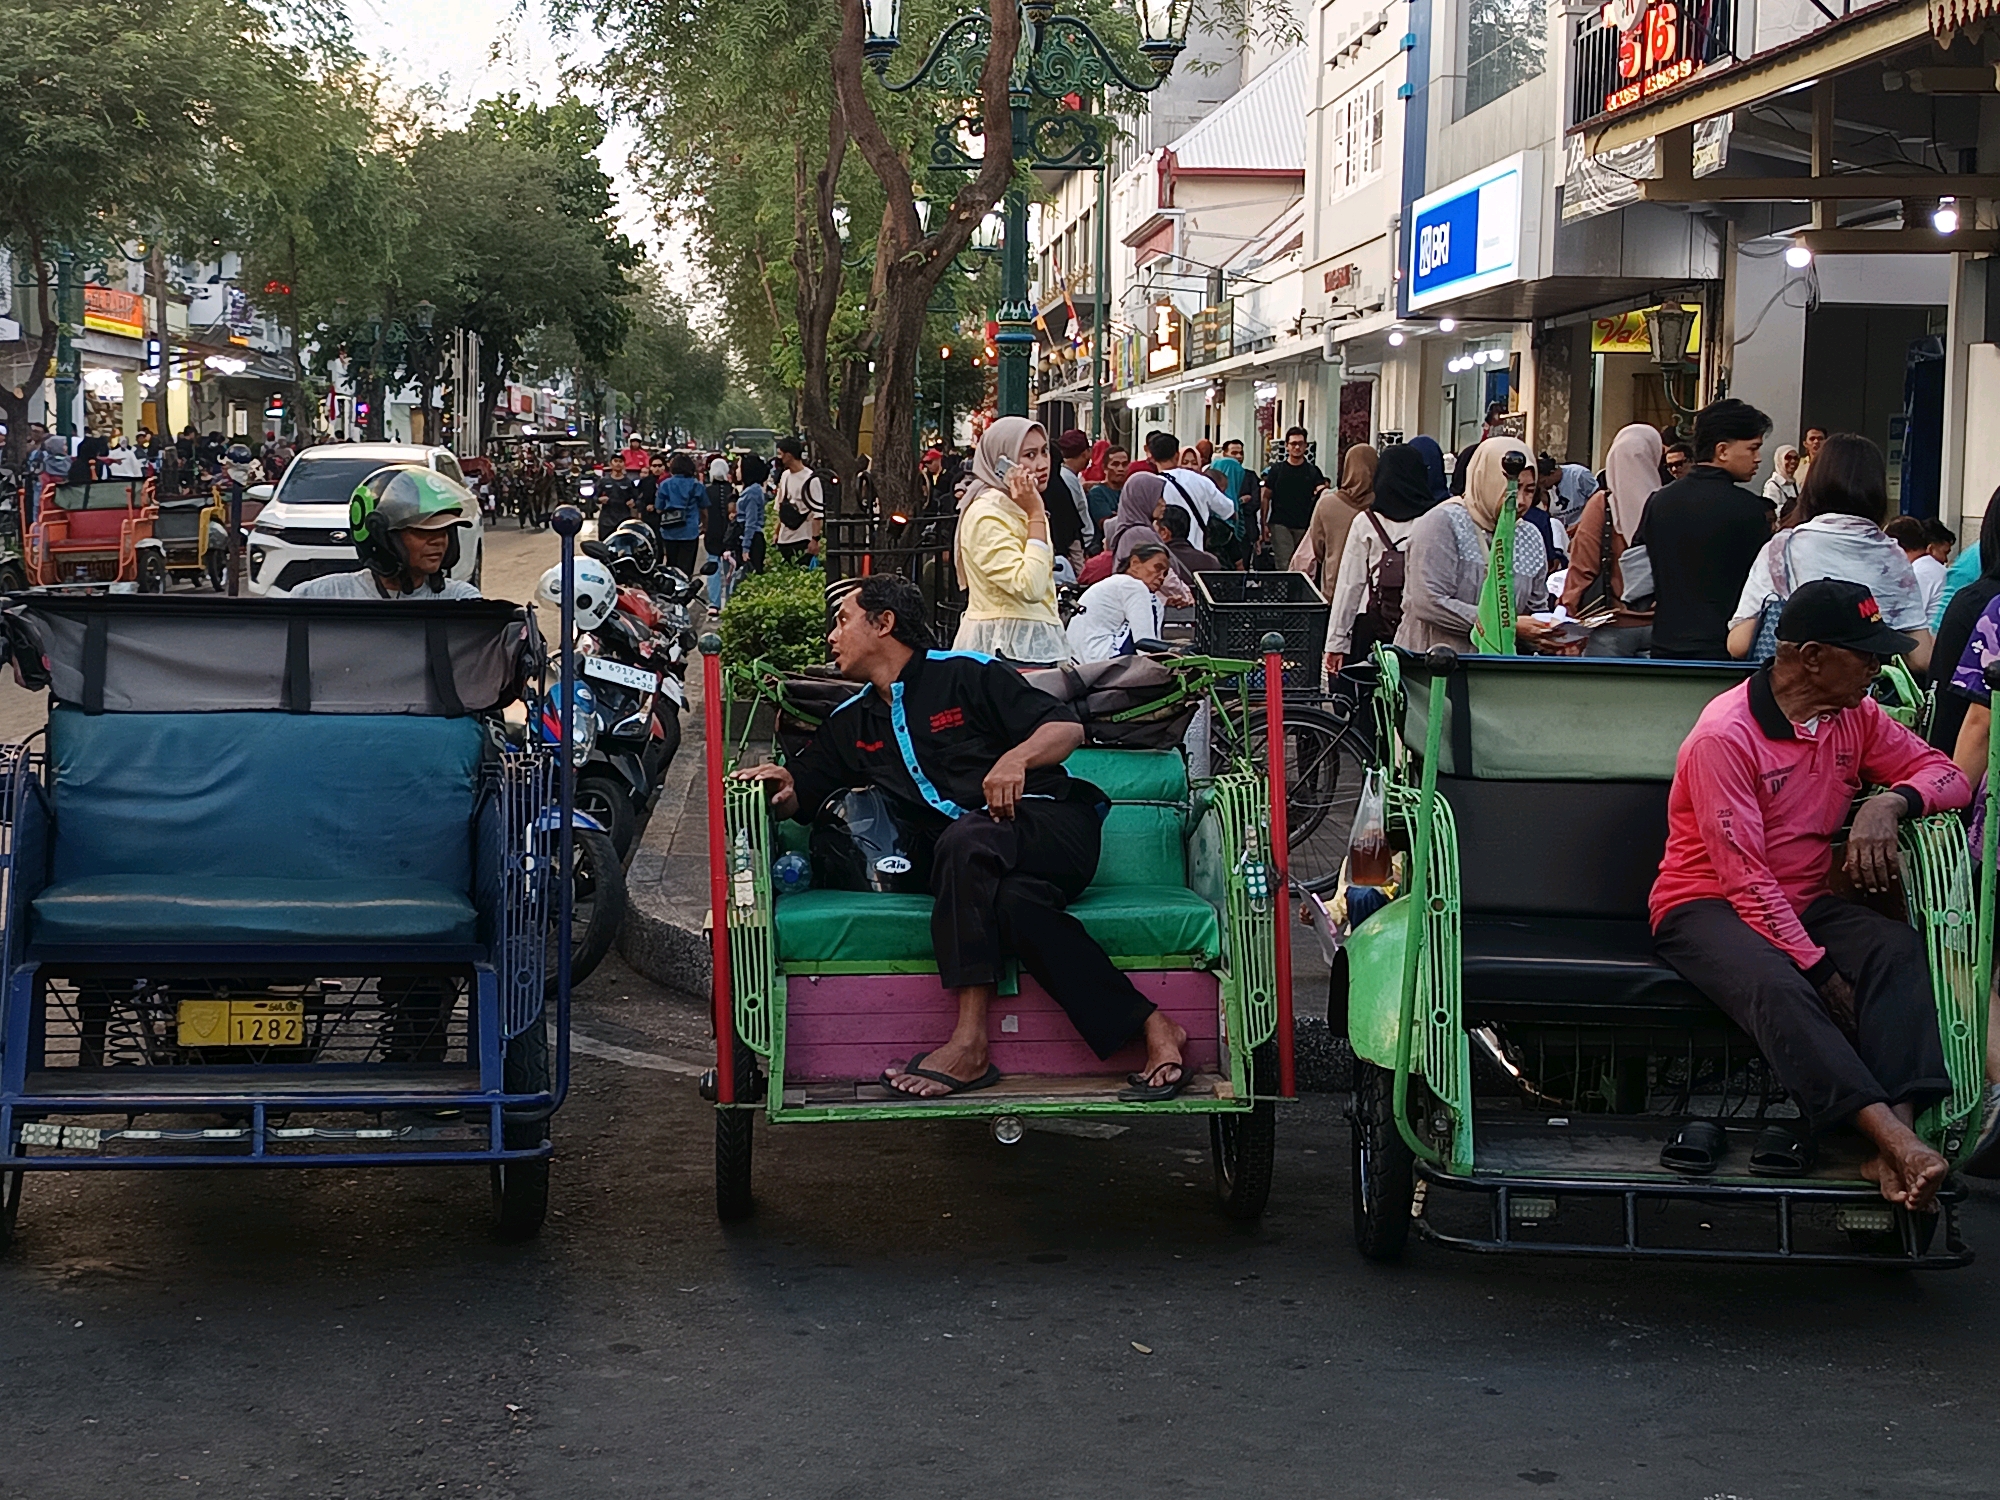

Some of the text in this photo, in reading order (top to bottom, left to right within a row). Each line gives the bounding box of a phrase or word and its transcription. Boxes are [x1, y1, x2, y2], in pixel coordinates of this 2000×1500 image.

[1431, 221, 1451, 269] BRI
[1495, 538, 1512, 629] BECAK MOTOR
[237, 1019, 297, 1040] 1282
